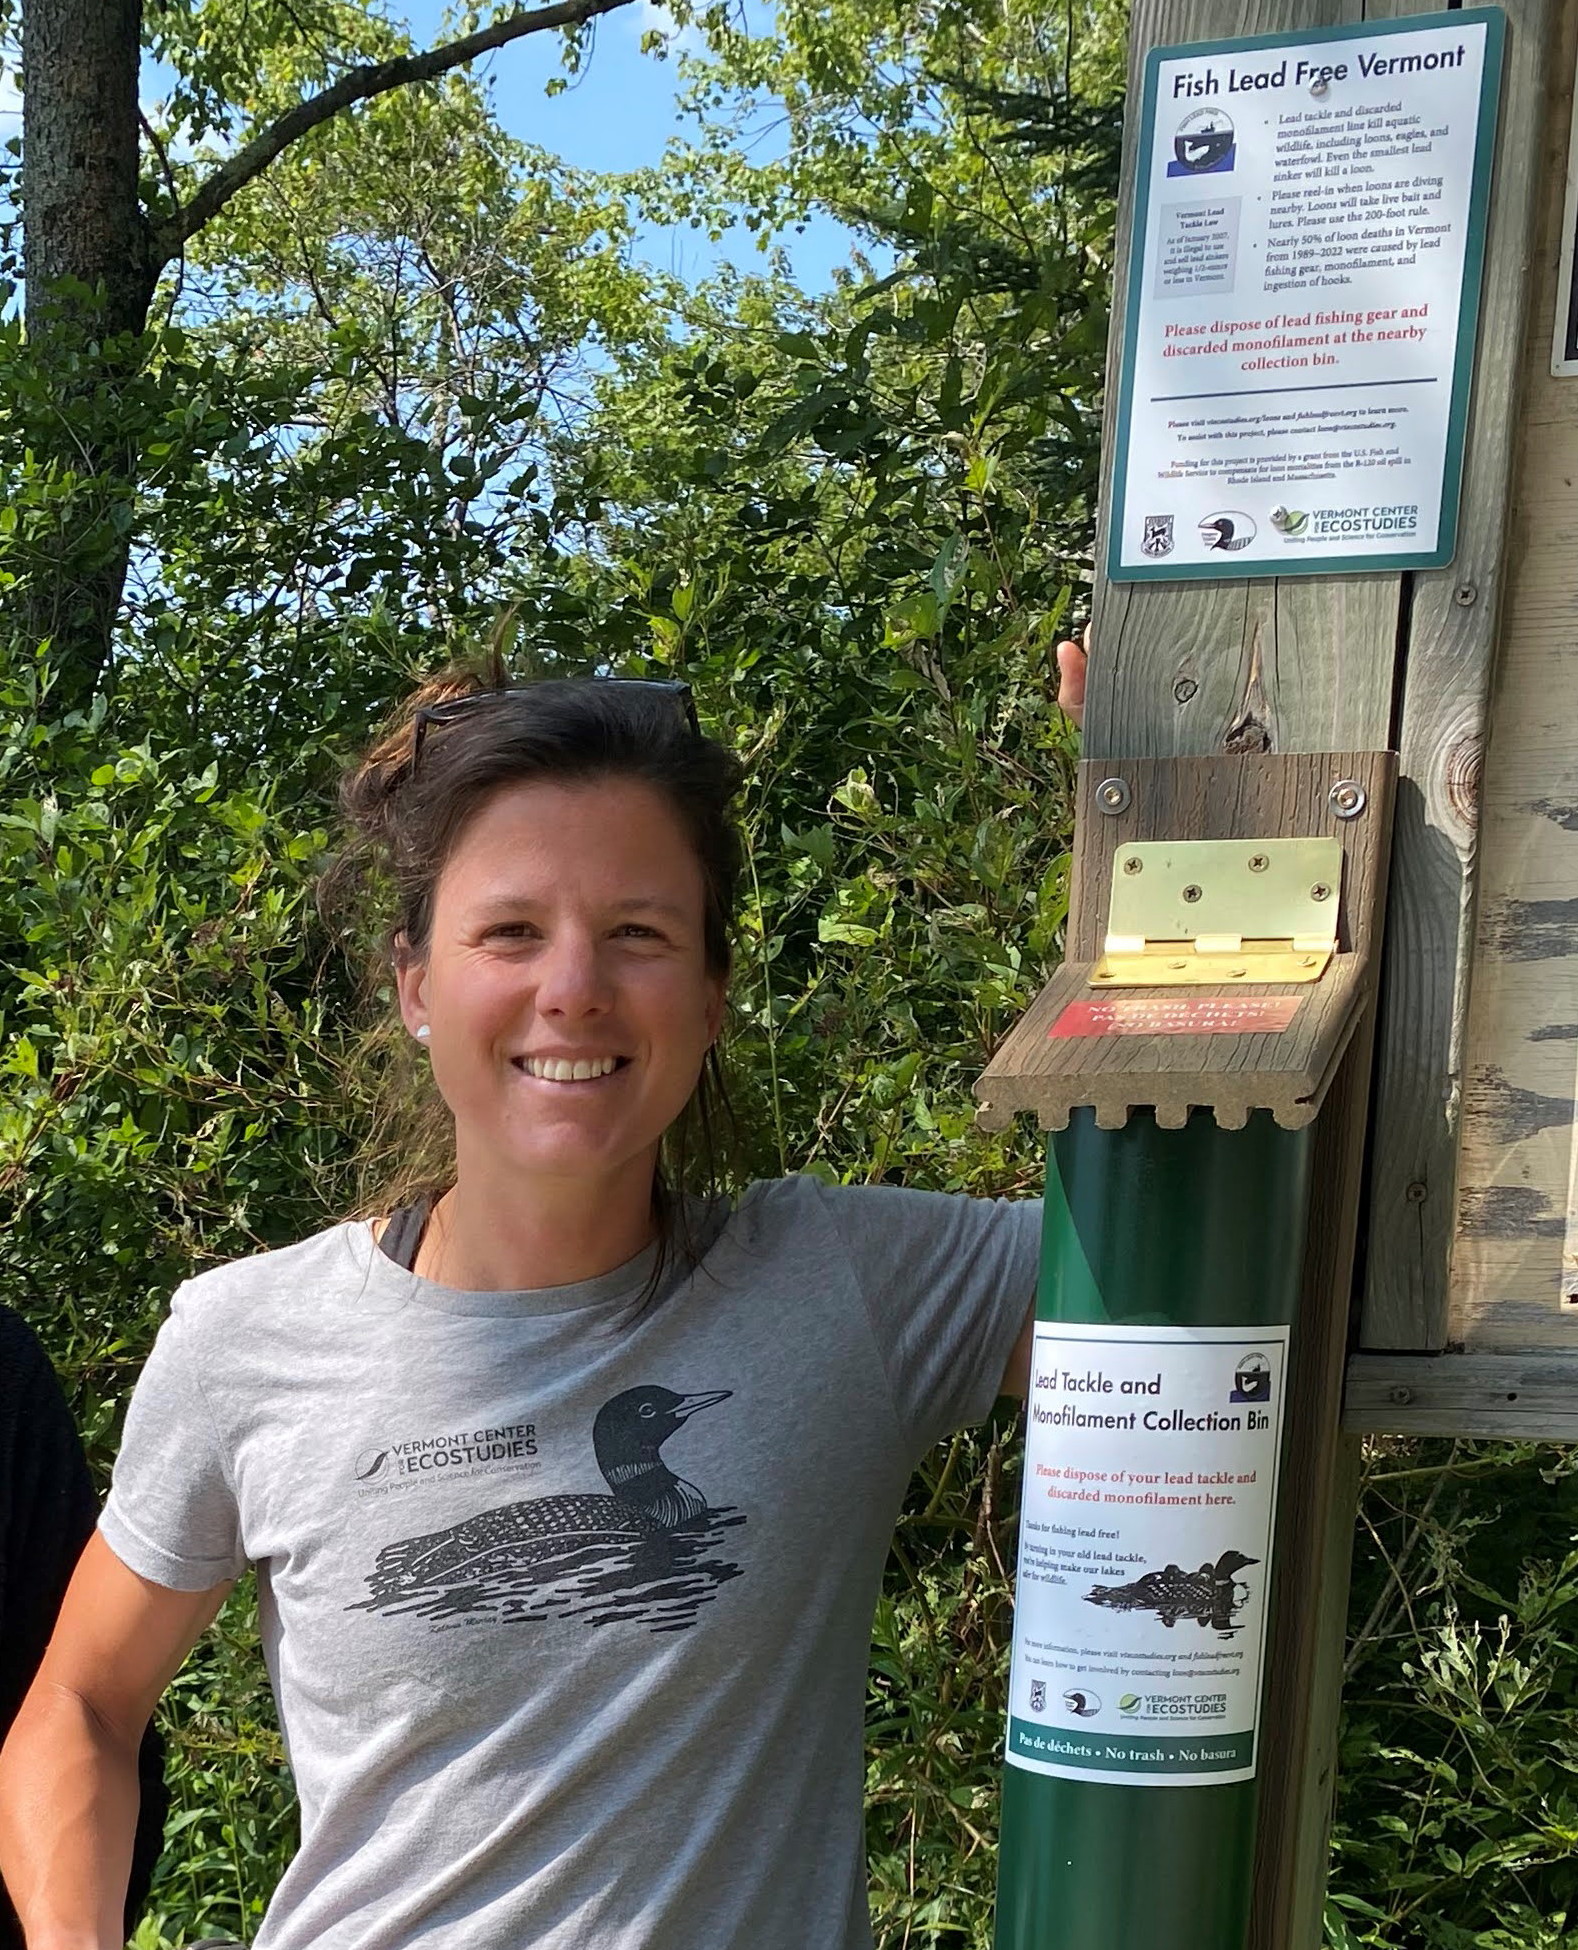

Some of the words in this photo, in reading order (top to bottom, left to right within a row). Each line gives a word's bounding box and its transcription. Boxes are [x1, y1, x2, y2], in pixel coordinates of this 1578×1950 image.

[1174, 69, 1218, 98] Fish
[1229, 61, 1287, 92] Lead
[1295, 61, 1348, 85] Free
[1358, 45, 1465, 78] Vermont
[1279, 112, 1301, 124] Lead
[1304, 110, 1332, 121] tackle
[1335, 107, 1353, 118] and
[1355, 102, 1402, 115] discarded
[1277, 125, 1344, 139] monofilament
[1347, 121, 1365, 130] line
[1368, 118, 1382, 129] kill
[1385, 115, 1420, 128] aquatic
[1316, 136, 1362, 149] including
[1364, 134, 1393, 144] loons,
[1396, 130, 1427, 141] eagles,
[1430, 126, 1449, 136] and
[1275, 154, 1323, 166] waterfowl.
[1327, 152, 1349, 162] Even
[1352, 149, 1368, 159] the
[1370, 146, 1409, 156] smallest
[1412, 142, 1432, 153] lead
[1274, 172, 1302, 181] sinker
[1305, 168, 1322, 178] will
[1325, 166, 1339, 176] kill
[1350, 164, 1374, 174] loon.
[1272, 191, 1301, 200] Please
[1304, 188, 1334, 197] reel-in
[1337, 184, 1363, 194] when
[1365, 181, 1392, 191] loons
[1395, 180, 1409, 188] are
[1412, 175, 1443, 187] diving
[1208, 208, 1224, 216] Lead
[1270, 204, 1304, 215] nearby.
[1308, 201, 1337, 211] Loons
[1340, 197, 1357, 207] will
[1360, 195, 1379, 205] take
[1382, 193, 1399, 203] live
[1402, 192, 1420, 201] bait
[1423, 189, 1441, 200] and
[1181, 221, 1202, 229] Tackle
[1269, 219, 1294, 229] lures.
[1297, 216, 1326, 226] Please
[1329, 215, 1344, 224] use
[1347, 212, 1363, 222] the
[1365, 208, 1405, 220] 200-foot
[1408, 207, 1430, 216] rule.
[1267, 236, 1299, 248] Nearly
[1302, 235, 1322, 245] 50%
[1325, 231, 1336, 242] of
[1337, 231, 1358, 240] loon
[1361, 228, 1392, 239] deaths
[1395, 227, 1404, 236] in
[1408, 224, 1451, 234] Vermont
[1266, 252, 1289, 262] from
[1345, 245, 1368, 254] were
[1370, 242, 1403, 253] caused
[1406, 240, 1418, 250] by
[1420, 237, 1440, 248] lead
[1265, 265, 1296, 276] fishing
[1299, 263, 1322, 276] gear,
[1324, 258, 1395, 271] monofilament,
[1398, 254, 1416, 265] and
[1264, 279, 1306, 291] ingestion
[1310, 276, 1320, 286] of
[1321, 275, 1352, 286] hooks.
[1165, 325, 1207, 338] Please
[1210, 320, 1261, 335] dispose
[1265, 316, 1280, 329] of
[1282, 313, 1311, 327] lead
[1315, 311, 1363, 325] fishing
[1366, 310, 1398, 322] gear
[1401, 304, 1428, 318] and
[1163, 340, 1227, 357] discarded
[1232, 335, 1329, 351] monofilament
[1333, 333, 1347, 344] at
[1351, 330, 1373, 342] the
[1377, 325, 1427, 341] nearby
[1241, 354, 1308, 371] collection
[1312, 353, 1339, 365] bin.
[1313, 508, 1370, 519] VERMONT
[1372, 505, 1418, 516] CENTER
[1322, 517, 1416, 532] ECOSTUDIES
[1035, 1369, 1057, 1389] Lead
[1062, 1371, 1113, 1393] Tackle
[1120, 1373, 1161, 1395] and
[1033, 1405, 1136, 1430] Monofilament
[1143, 1410, 1240, 1431] Collection
[1247, 1410, 1269, 1430] Bin
[392, 1433, 468, 1456] VERMONT
[473, 1425, 536, 1442] CENTER
[408, 1439, 538, 1472] ECOSTUDIES
[420, 1476, 435, 1485] and
[485, 1461, 541, 1474] Conservation
[1036, 1464, 1061, 1478] Please
[1064, 1466, 1107, 1483] dispose
[1111, 1471, 1126, 1482] of
[1128, 1474, 1161, 1485] your
[1165, 1472, 1193, 1484] lead
[1198, 1471, 1234, 1484] tackle
[1237, 1471, 1256, 1483] and
[1048, 1486, 1100, 1501] discarded
[1104, 1492, 1201, 1505] monofilament
[1205, 1493, 1236, 1505] here.
[1042, 1524, 1050, 1532] for
[1052, 1524, 1076, 1538] fishing
[1078, 1526, 1095, 1537] lead
[1098, 1529, 1119, 1539] free!
[1077, 1550, 1090, 1559] old
[1093, 1551, 1112, 1560] lead
[1116, 1552, 1147, 1563] tackle,
[1060, 1564, 1080, 1572] make
[1101, 1566, 1125, 1576] lakes
[1153, 1703, 1226, 1714] ECOSTUDIES
[1195, 1694, 1226, 1702] CENTER
[1020, 1732, 1032, 1746] Pas
[1034, 1737, 1045, 1749] de
[1047, 1739, 1091, 1756] déchets
[1105, 1747, 1126, 1759] No
[1129, 1749, 1164, 1761] trash
[1179, 1749, 1197, 1760] No
[1201, 1749, 1236, 1760] basura
